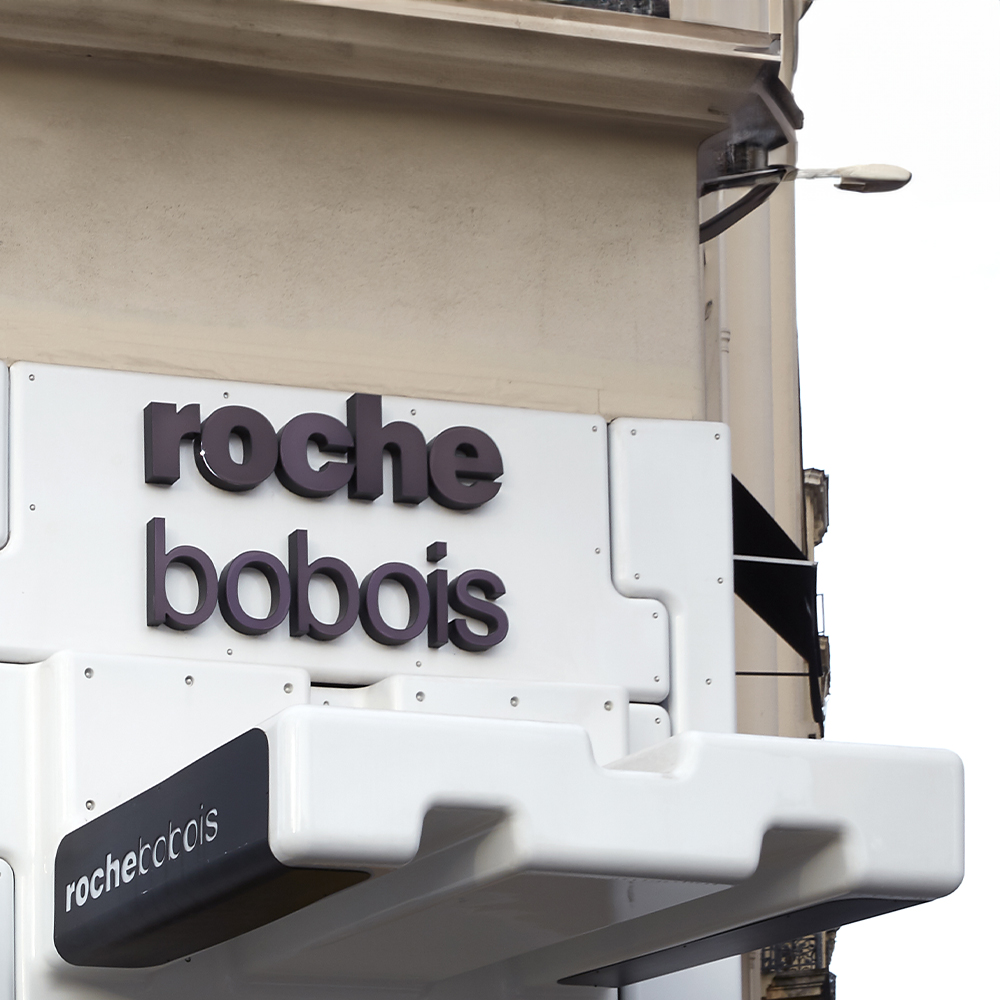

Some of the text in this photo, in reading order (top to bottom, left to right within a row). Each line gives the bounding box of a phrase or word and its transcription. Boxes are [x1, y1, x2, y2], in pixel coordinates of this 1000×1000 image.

[143, 392, 504, 511] roche
[146, 517, 509, 653] bobois
[65, 803, 219, 914] rochebobois
